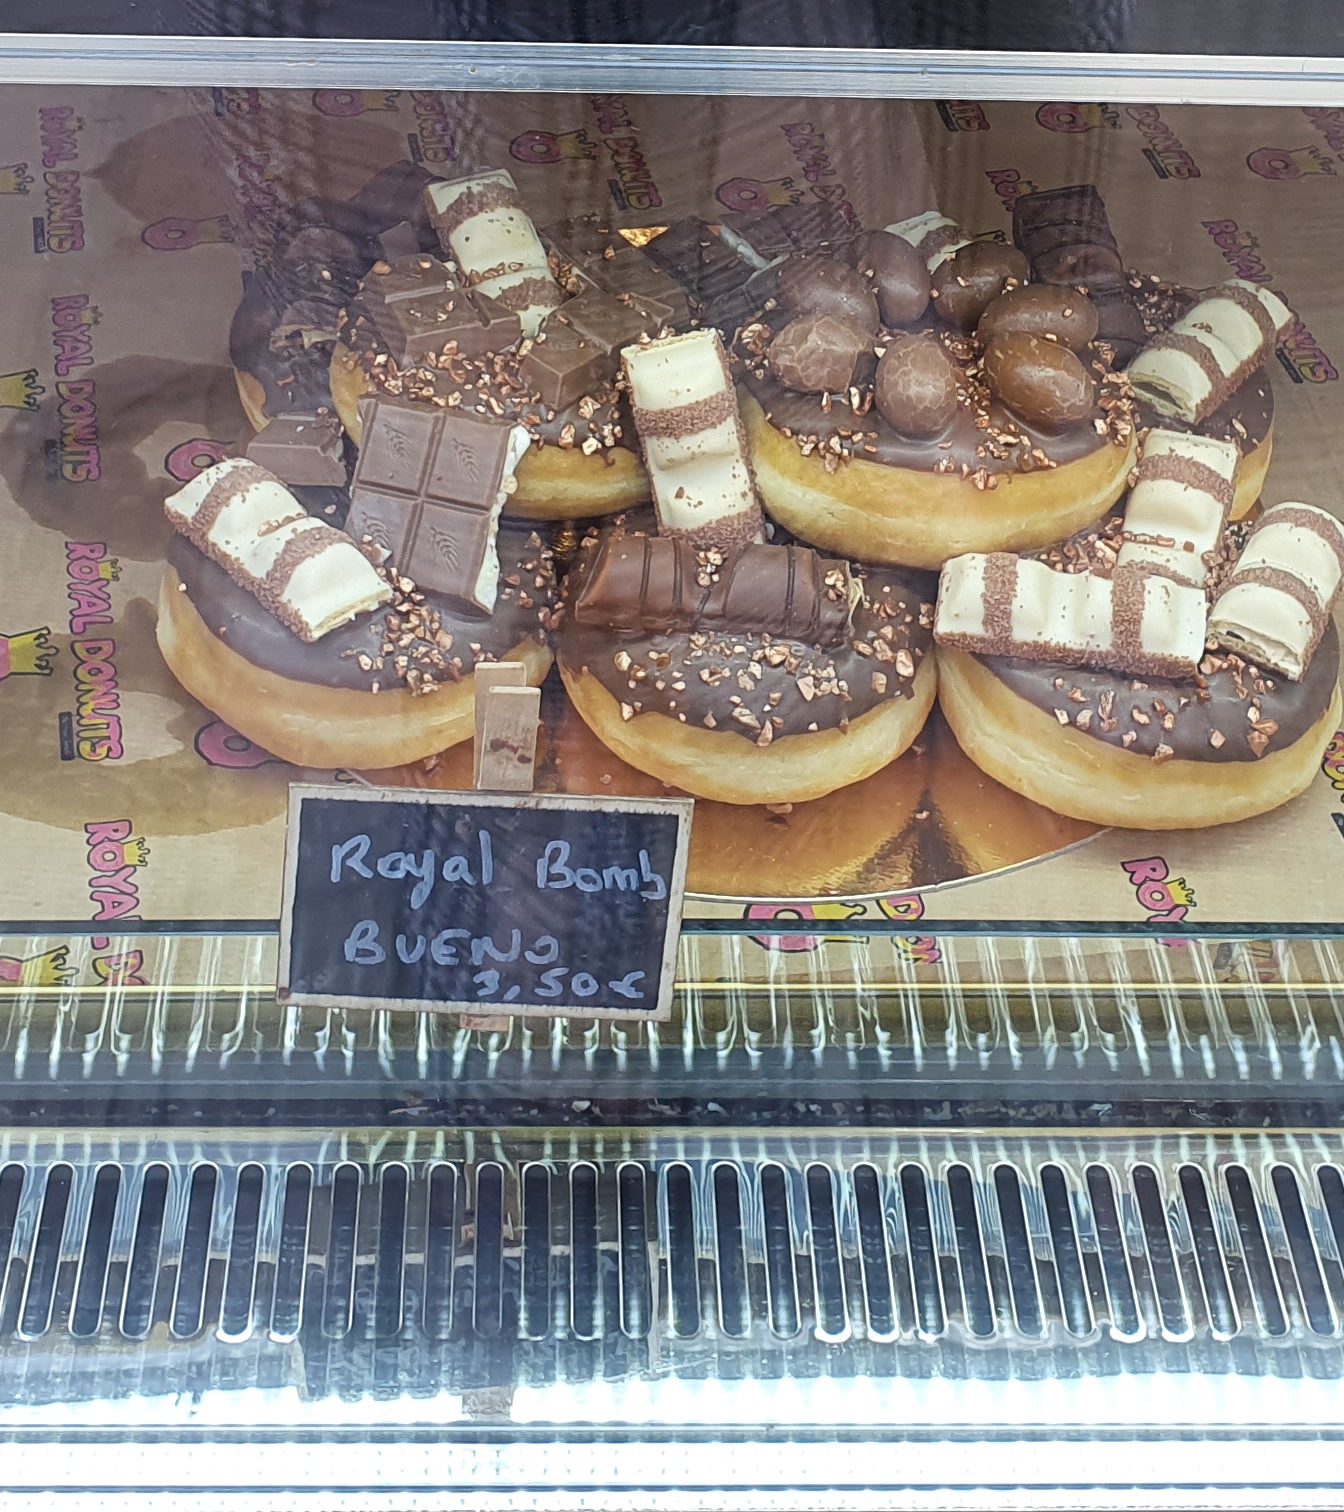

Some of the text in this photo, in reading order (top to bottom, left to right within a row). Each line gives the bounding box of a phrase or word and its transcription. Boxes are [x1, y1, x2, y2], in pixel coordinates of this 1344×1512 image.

[51, 294, 102, 483] ROYAL DONUTS
[65, 541, 124, 762] ROYAL DONUTS
[330, 828, 668, 910] Royal Bomb
[343, 919, 561, 967] BUENO
